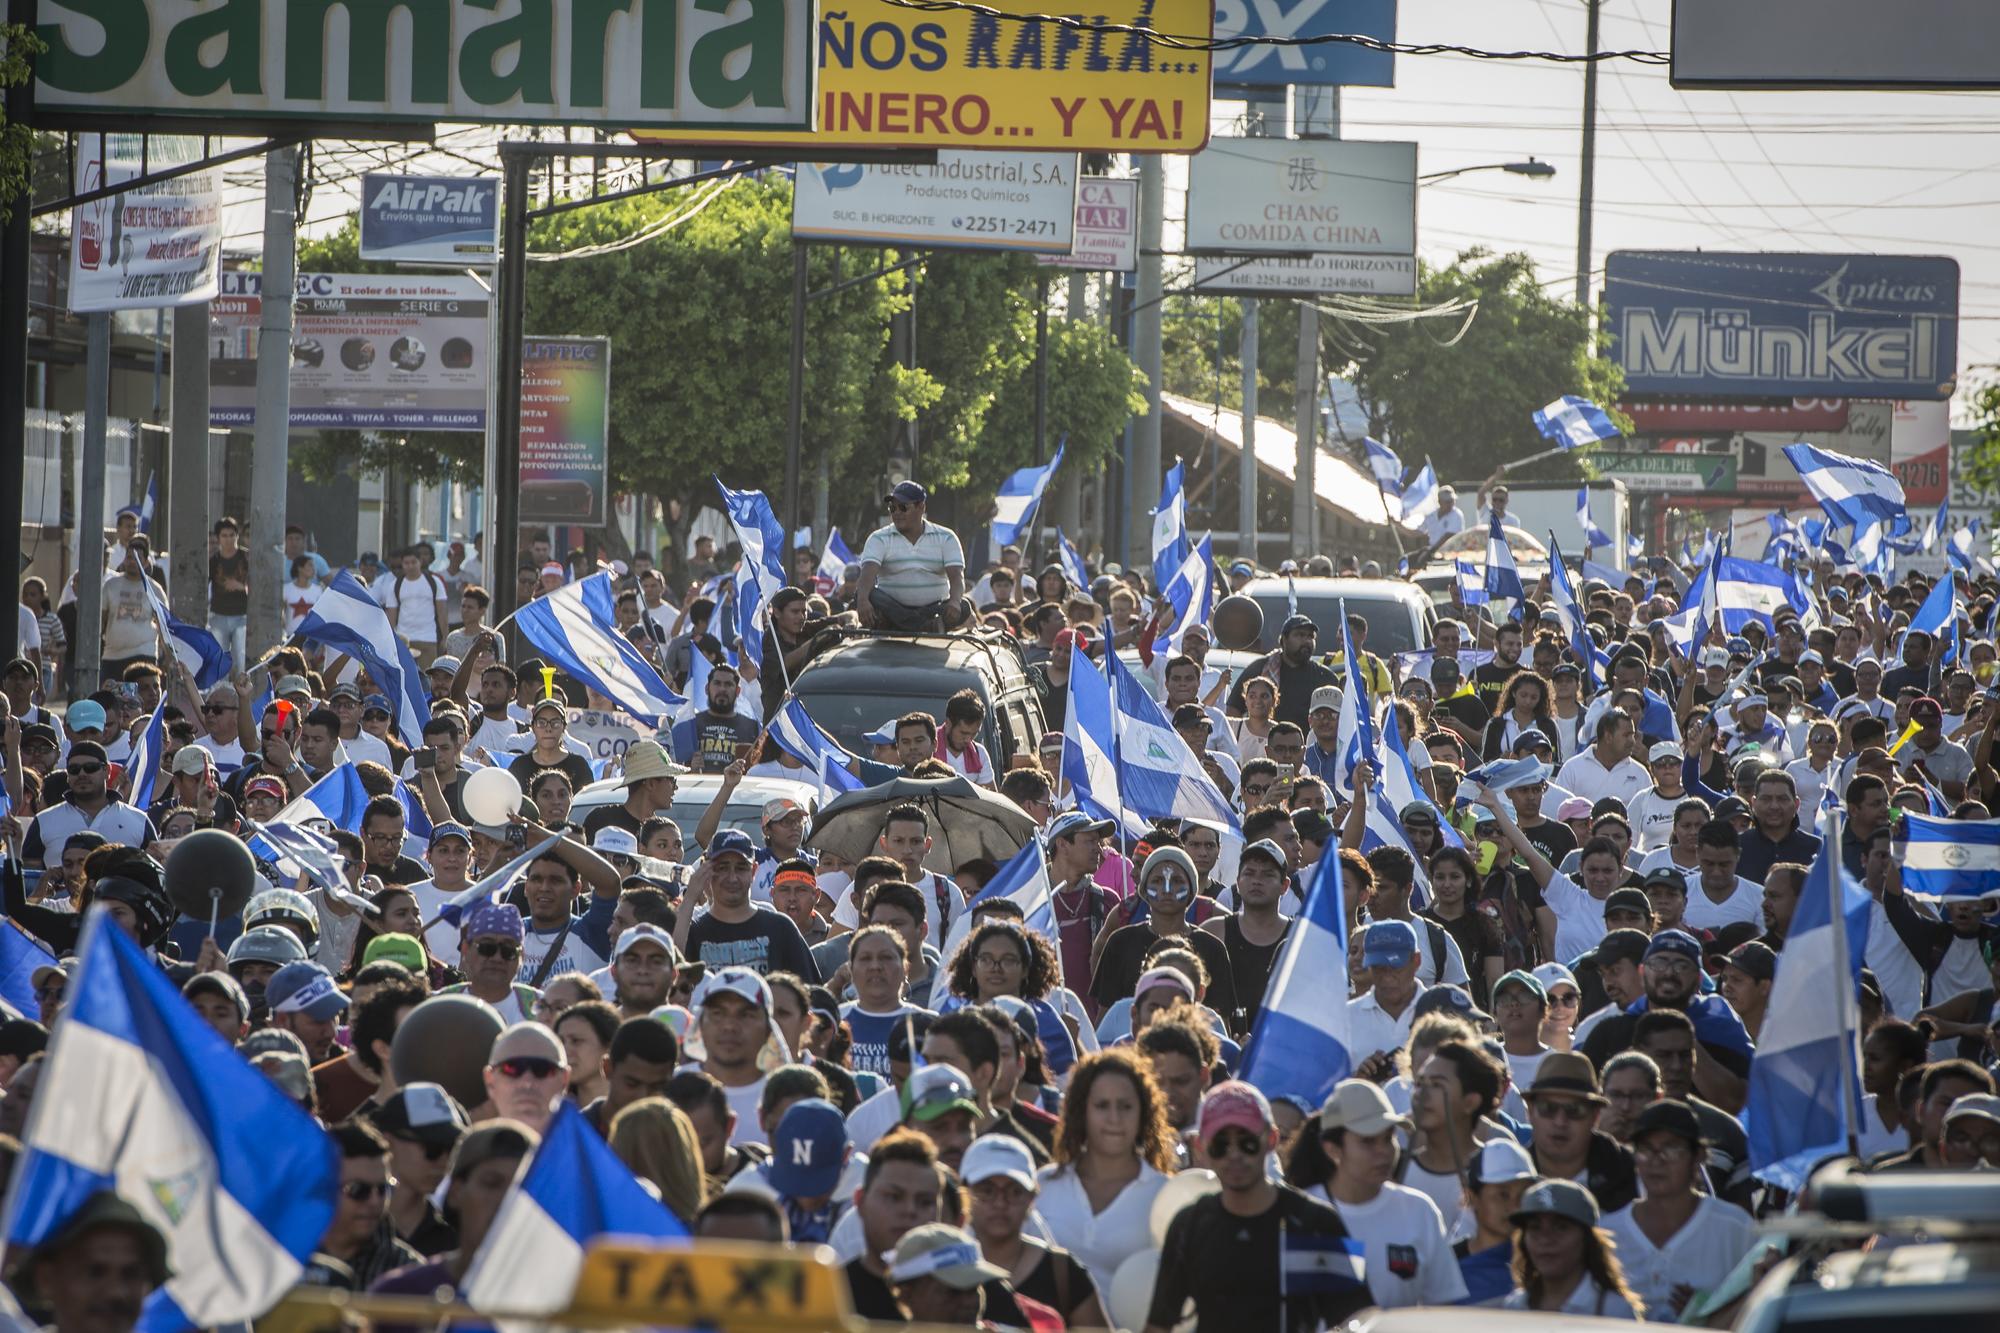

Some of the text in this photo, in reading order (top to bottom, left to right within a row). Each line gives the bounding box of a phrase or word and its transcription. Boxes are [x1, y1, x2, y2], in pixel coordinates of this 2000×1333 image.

[824, 91, 1183, 140] INERO... Y YA!
[1032, 162, 1068, 187] S.A.
[1287, 156, 1320, 192] 張
[370, 182, 483, 213] AirPak
[905, 183, 968, 200] Productos
[1081, 185, 1116, 205] CA
[416, 213, 435, 224] que
[436, 214, 455, 223] nos
[456, 215, 482, 224] unen
[871, 213, 936, 226] HORIZONTE
[1263, 203, 1340, 222] CHANG
[965, 216, 1057, 236] 2251-2471
[1218, 223, 1382, 244] COMIDA CHINA
[1327, 258, 1414, 273] HORIZONTE
[340, 286, 352, 295] El
[354, 286, 383, 296] color
[385, 286, 398, 296] de
[400, 287, 417, 296] tus
[400, 301, 442, 313] SERIE
[446, 301, 459, 313] G
[1622, 306, 1939, 384] Münkel
[352, 413, 385, 423] TINTAS
[393, 414, 425, 423] TONER
[432, 414, 478, 424] RELLENOS
[534, 453, 594, 461] IMPRESORAS
[1641, 456, 1670, 472] DEL
[1672, 458, 1697, 473] PIE
[597, 738, 641, 758] CO
[792, 1137, 814, 1166] N
[602, 1255, 807, 1310] TAXI
